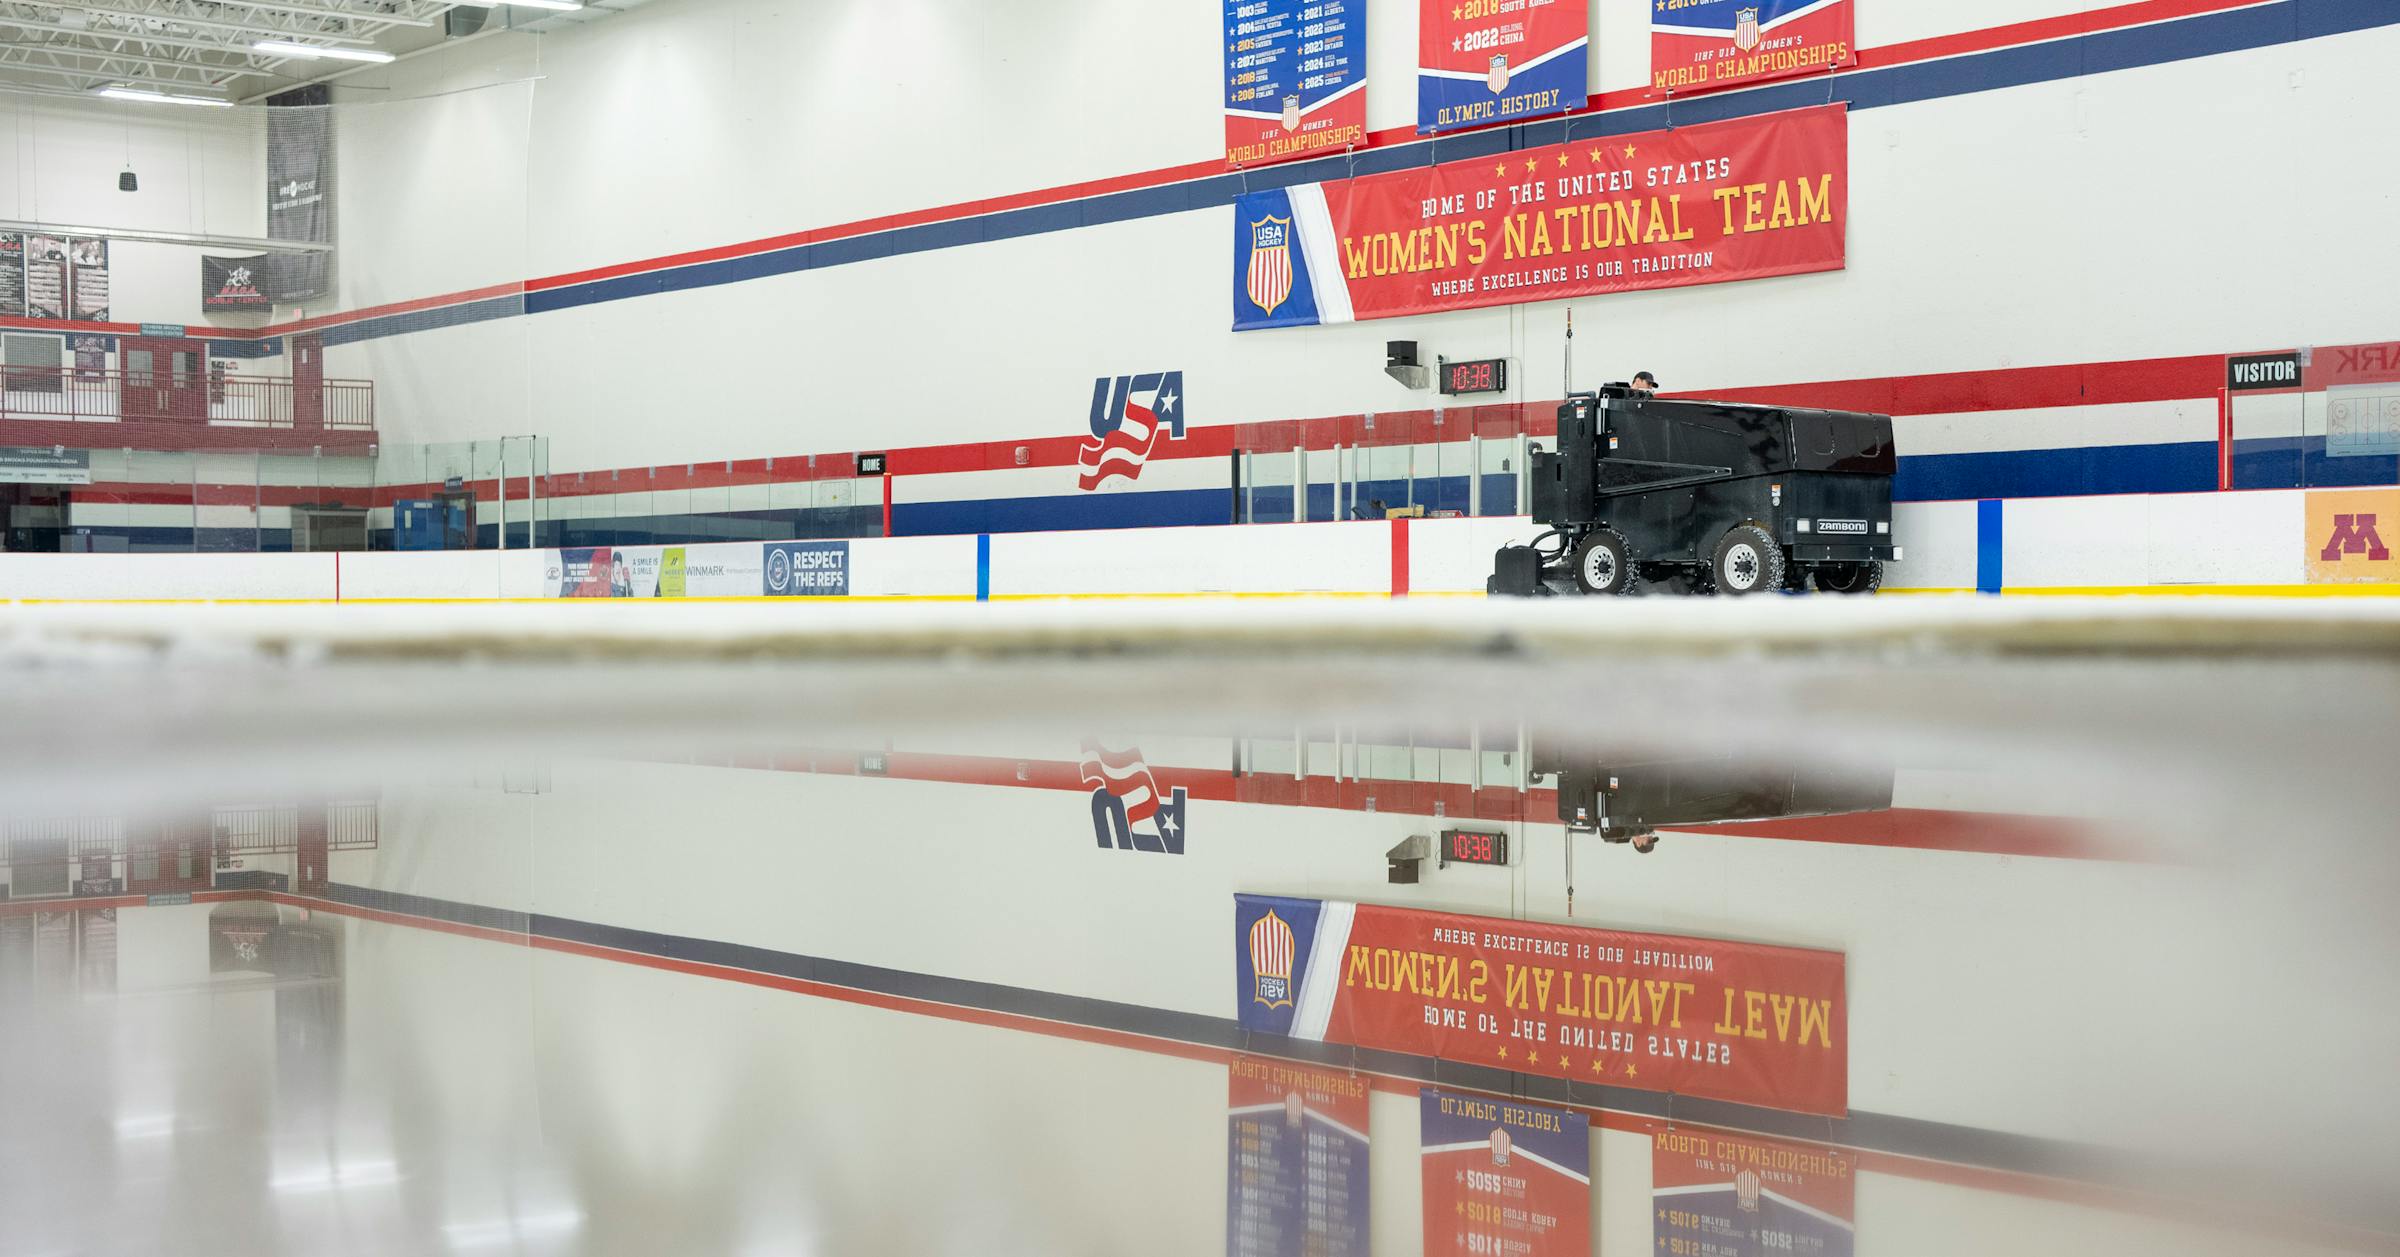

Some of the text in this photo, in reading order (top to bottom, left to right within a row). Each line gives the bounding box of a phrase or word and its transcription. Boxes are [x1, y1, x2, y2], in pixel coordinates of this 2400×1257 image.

[1304, 6, 1323, 20] 2021
[1464, 0, 1498, 20] 2018
[1500, 1, 1526, 14] SOUTH
[1304, 23, 1324, 38] 2022
[1500, 32, 1525, 45] CHINA
[1304, 40, 1323, 55] 2023
[1464, 28, 1499, 51] 2022
[1694, 35, 1803, 62] IIHF U18 WOMEN'S
[1304, 57, 1324, 72] 2024
[1654, 42, 1848, 89] WORLD CHAMPIONSHIPS
[1305, 75, 1324, 90] 2025
[1438, 89, 1560, 125] OLYMPIC HISTORY
[1303, 118, 1334, 132] WOMEN'S
[1228, 125, 1361, 164] WORLD CHAMPIONSHIPS
[1422, 157, 1731, 218] HOME OF THE UNITED STATES
[1257, 226, 1283, 241] USA
[1343, 173, 1832, 280] WOMEN'S NATIONAL TEAM
[1258, 238, 1283, 247] HOCKEY
[1432, 251, 1713, 297] WHERE EXCELLENCE IS OUR TRADITION
[1453, 363, 1491, 389] 10:38
[2234, 360, 2296, 383] VISITOR
[1082, 371, 1187, 468] USA
[862, 458, 881, 471] HOME
[1819, 522, 1865, 531] ZAMBONI
[2321, 513, 2389, 561] M
[794, 550, 844, 569] RESPECT
[686, 565, 725, 577] WINMARK
[794, 571, 843, 587] THE REFS
